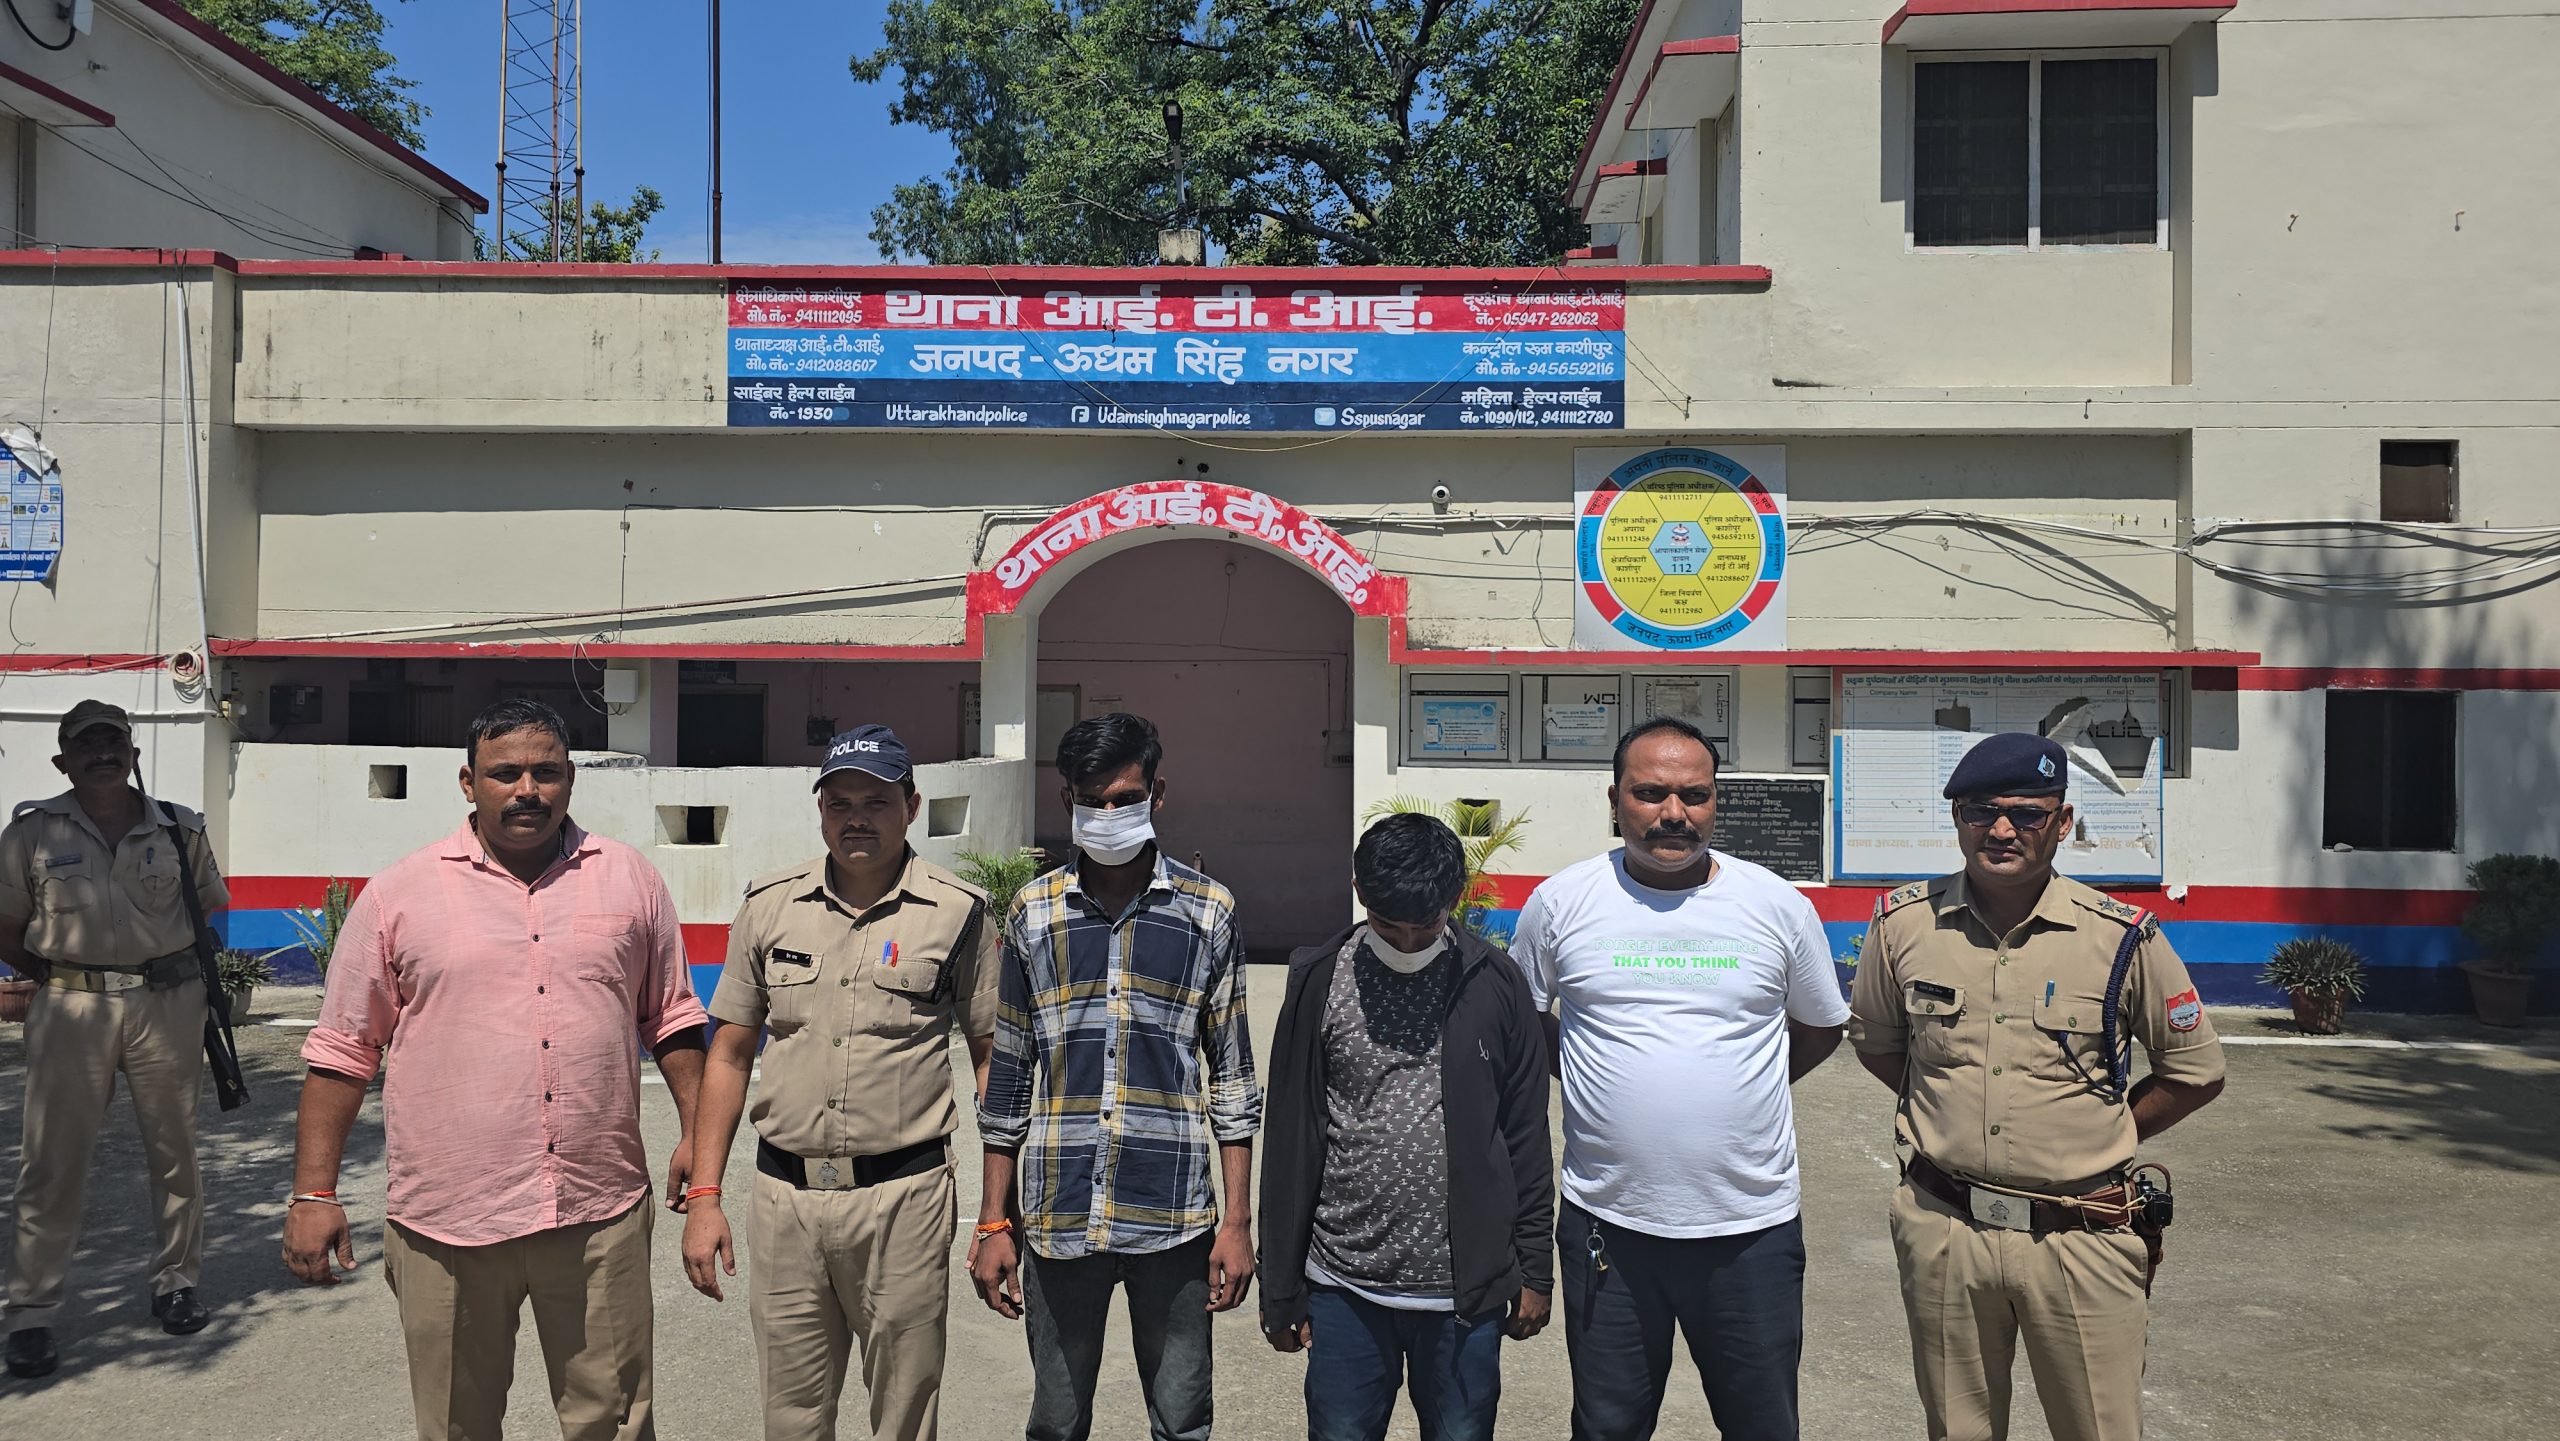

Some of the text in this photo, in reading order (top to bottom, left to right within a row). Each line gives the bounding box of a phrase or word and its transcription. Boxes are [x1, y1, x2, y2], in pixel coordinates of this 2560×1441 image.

[735, 285, 862, 309] क्षेत्राधिकारी काशीपुर
[794, 308, 862, 324] 9411112095
[885, 283, 1433, 335] थाना आई. टी. आई.
[735, 337, 798, 355] थानाध्यक्ष
[1524, 342, 1554, 355] रूम
[1555, 337, 1614, 359] काशीपुर
[909, 343, 1026, 378] जनपद
[1052, 343, 1157, 374] ऊधम
[1175, 337, 1247, 385] सिंह
[1268, 346, 1359, 375] नगर
[733, 383, 855, 403] साईबर हेल्प लाईन
[1460, 386, 1602, 408] महिला हेल्प लाईन
[886, 404, 1028, 424] Uttarakhandpolice
[1098, 406, 1251, 429] Udamsinghnagarpolice
[1340, 407, 1426, 428] Sspusnagar
[1656, 453, 1689, 468] पुलिस
[1610, 516, 1629, 526] पुलिस
[1704, 515, 1723, 525] पुलिस
[996, 503, 1104, 590] थाना
[1672, 563, 1692, 573] 112
[1713, 562, 1726, 570] आई
[1737, 562, 1750, 570] आई
[1694, 631, 1713, 642] सिंह
[1715, 621, 1734, 634] नगर
[829, 739, 880, 760] POLICE
[1595, 938, 1759, 954] FORGET EVERYTHING
[1613, 955, 1739, 969] THAT YOU THINK
[1633, 973, 1720, 985] YOU KNOW
